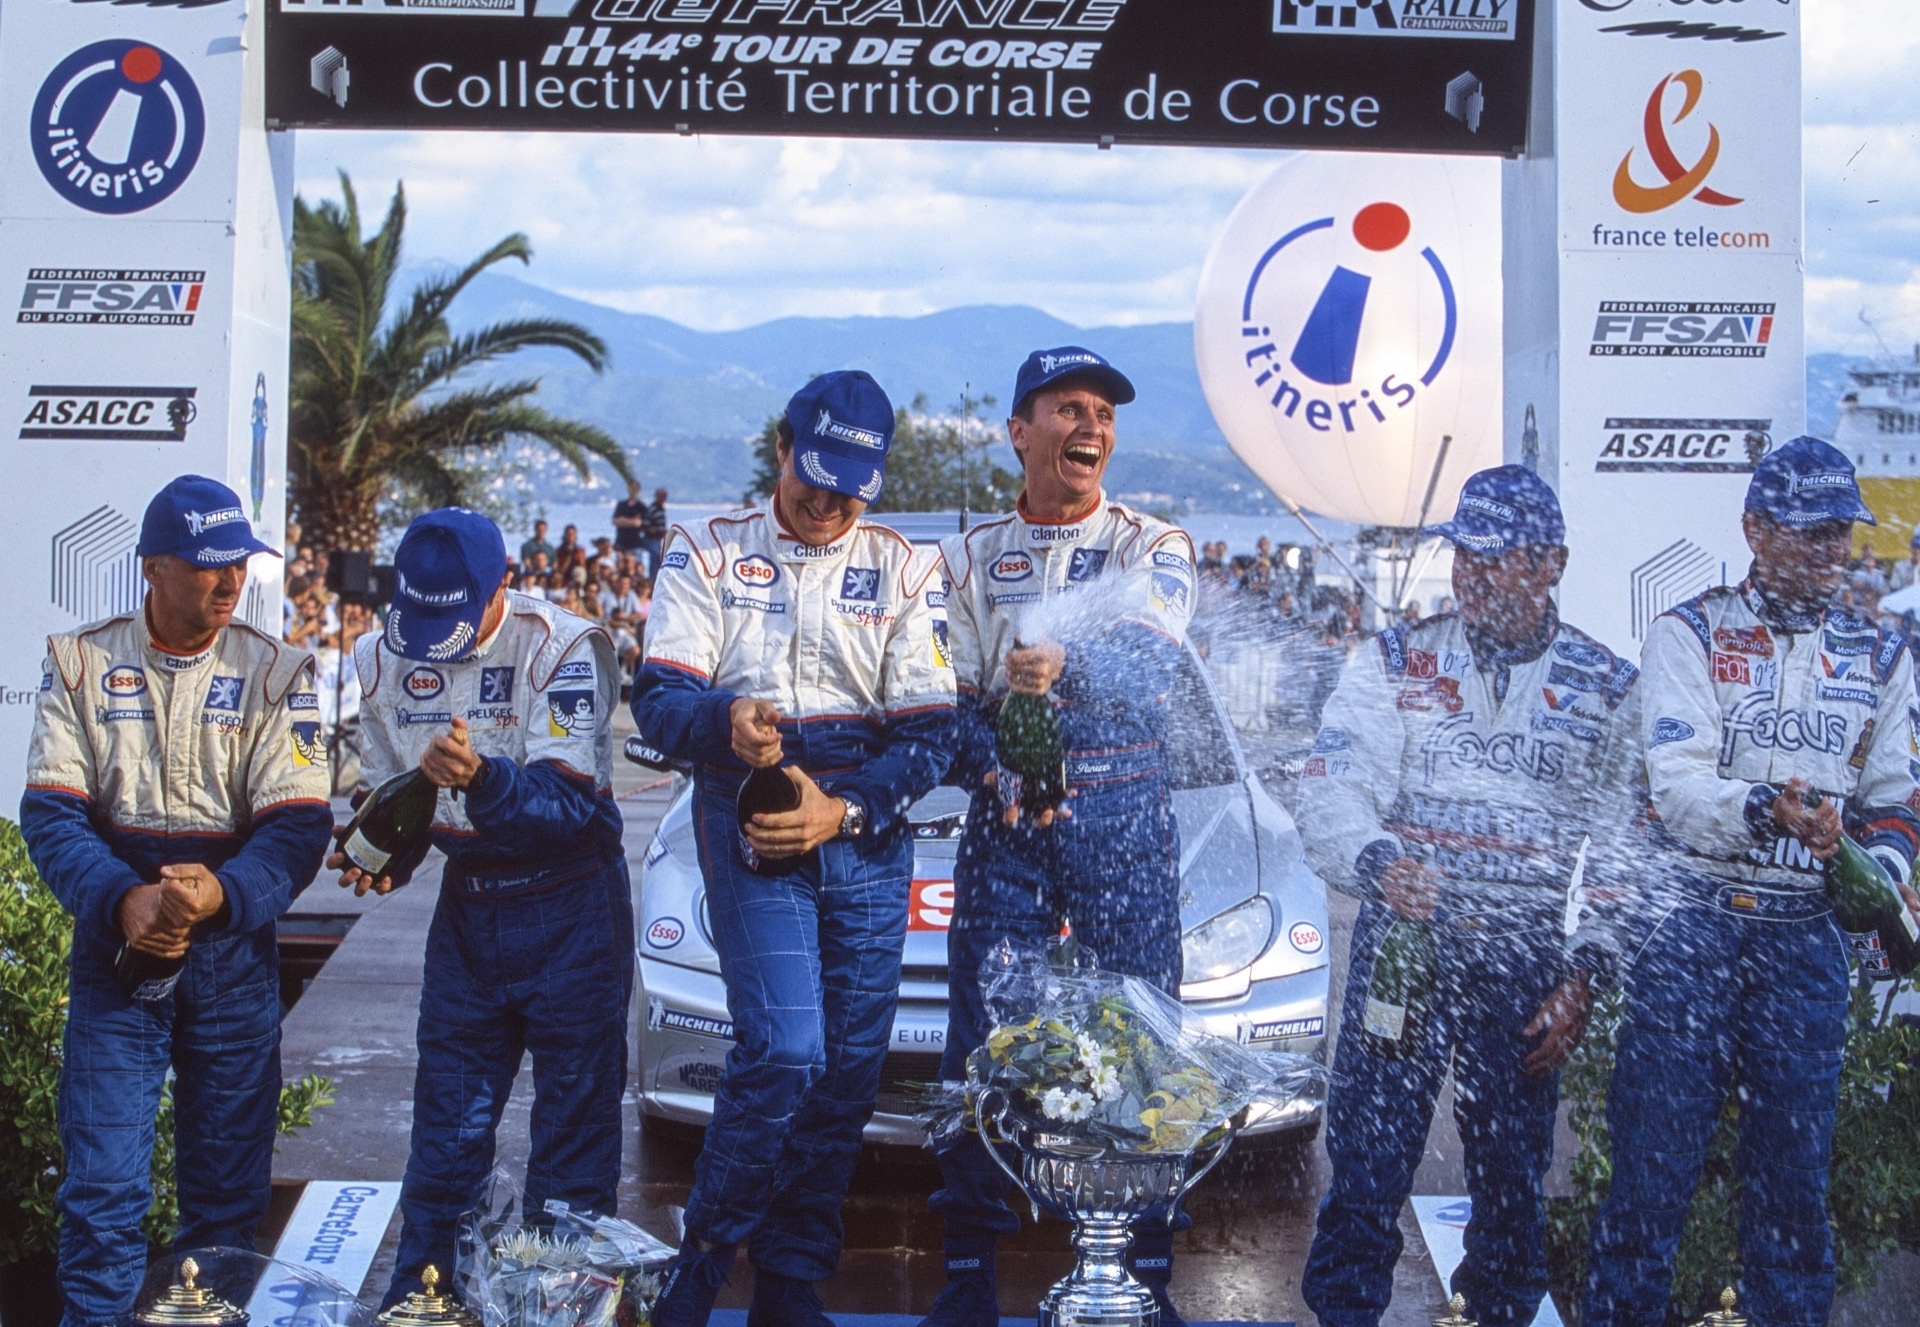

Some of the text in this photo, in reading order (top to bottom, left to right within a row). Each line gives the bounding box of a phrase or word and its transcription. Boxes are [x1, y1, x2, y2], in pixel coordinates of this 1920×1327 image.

[1402, 18, 1507, 32] CHAMPIONSHIP
[711, 34, 841, 64] TOUR
[848, 38, 922, 66] DE
[928, 40, 1102, 70] CORSE
[413, 60, 1380, 128] Collectivité Territoriale de Corse
[48, 128, 164, 198] itineris
[1593, 224, 1770, 248] france telecom
[32, 270, 203, 281] FEDERATION FRANÇAISE
[20, 283, 175, 311] FFSA
[1603, 302, 1773, 314] FEDERATION FRANÇAISE
[22, 314, 190, 325] DU SPORT AUTOMOBILE
[1593, 316, 1747, 343] FFSA
[1595, 345, 1765, 357] DU SPORT AUTOMOBILE
[1242, 326, 1416, 432] itineris
[23, 400, 154, 425] ASACC
[830, 423, 884, 447] MICHELIN
[1599, 433, 1731, 458] ASACC
[407, 587, 464, 603] MICHELIN
[734, 598, 784, 613] MICHELIN
[831, 598, 888, 617] PEUGEOT
[856, 611, 896, 627] sport
[1832, 612, 1865, 627] Ford
[625, 742, 664, 764] NIKKO
[1253, 1018, 1323, 1038] MICHELIN
[304, 1186, 379, 1264] Carrefour
[1135, 1258, 1168, 1268] sparco
